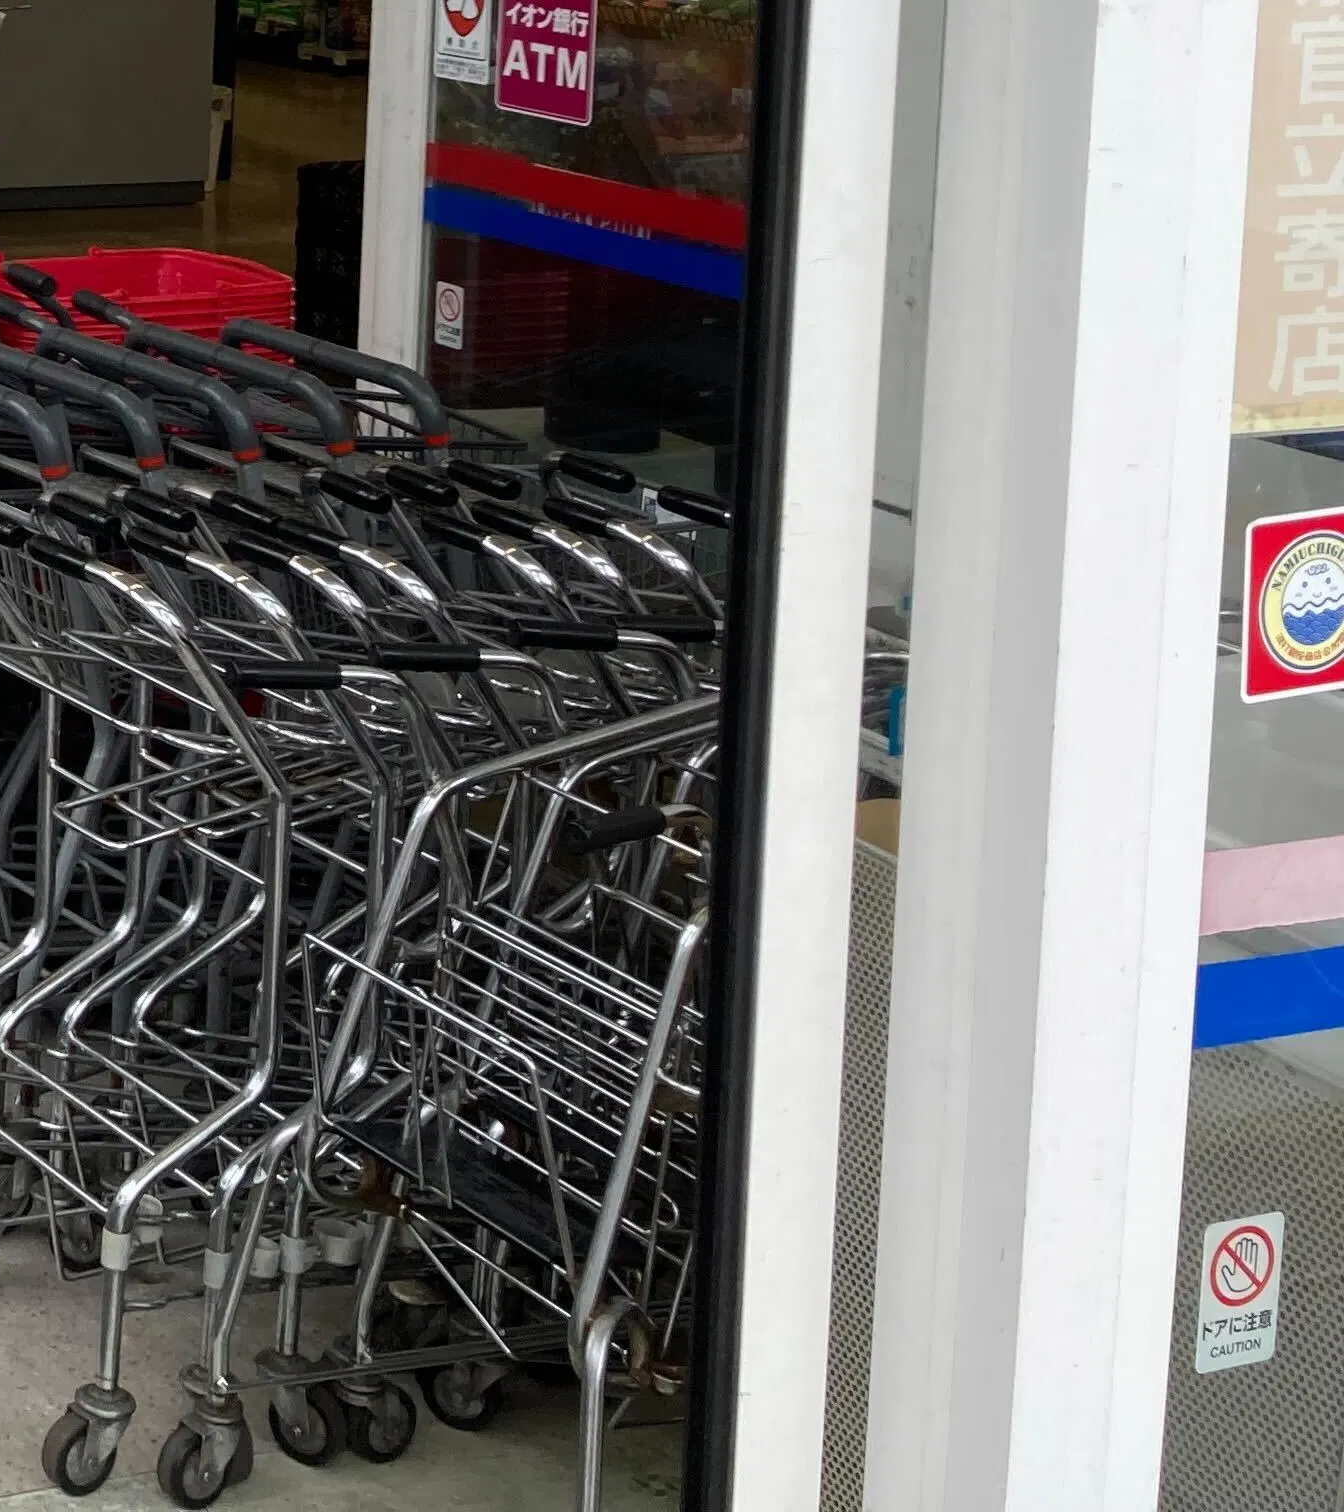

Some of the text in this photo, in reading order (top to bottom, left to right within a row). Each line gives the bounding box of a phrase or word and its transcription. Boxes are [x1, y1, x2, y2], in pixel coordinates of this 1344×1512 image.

[505, 1, 590, 38] イオン銀行
[503, 40, 589, 91] ATM
[1201, 1309, 1272, 1341] ドアに注意
[1210, 1337, 1261, 1359] CAUTION
